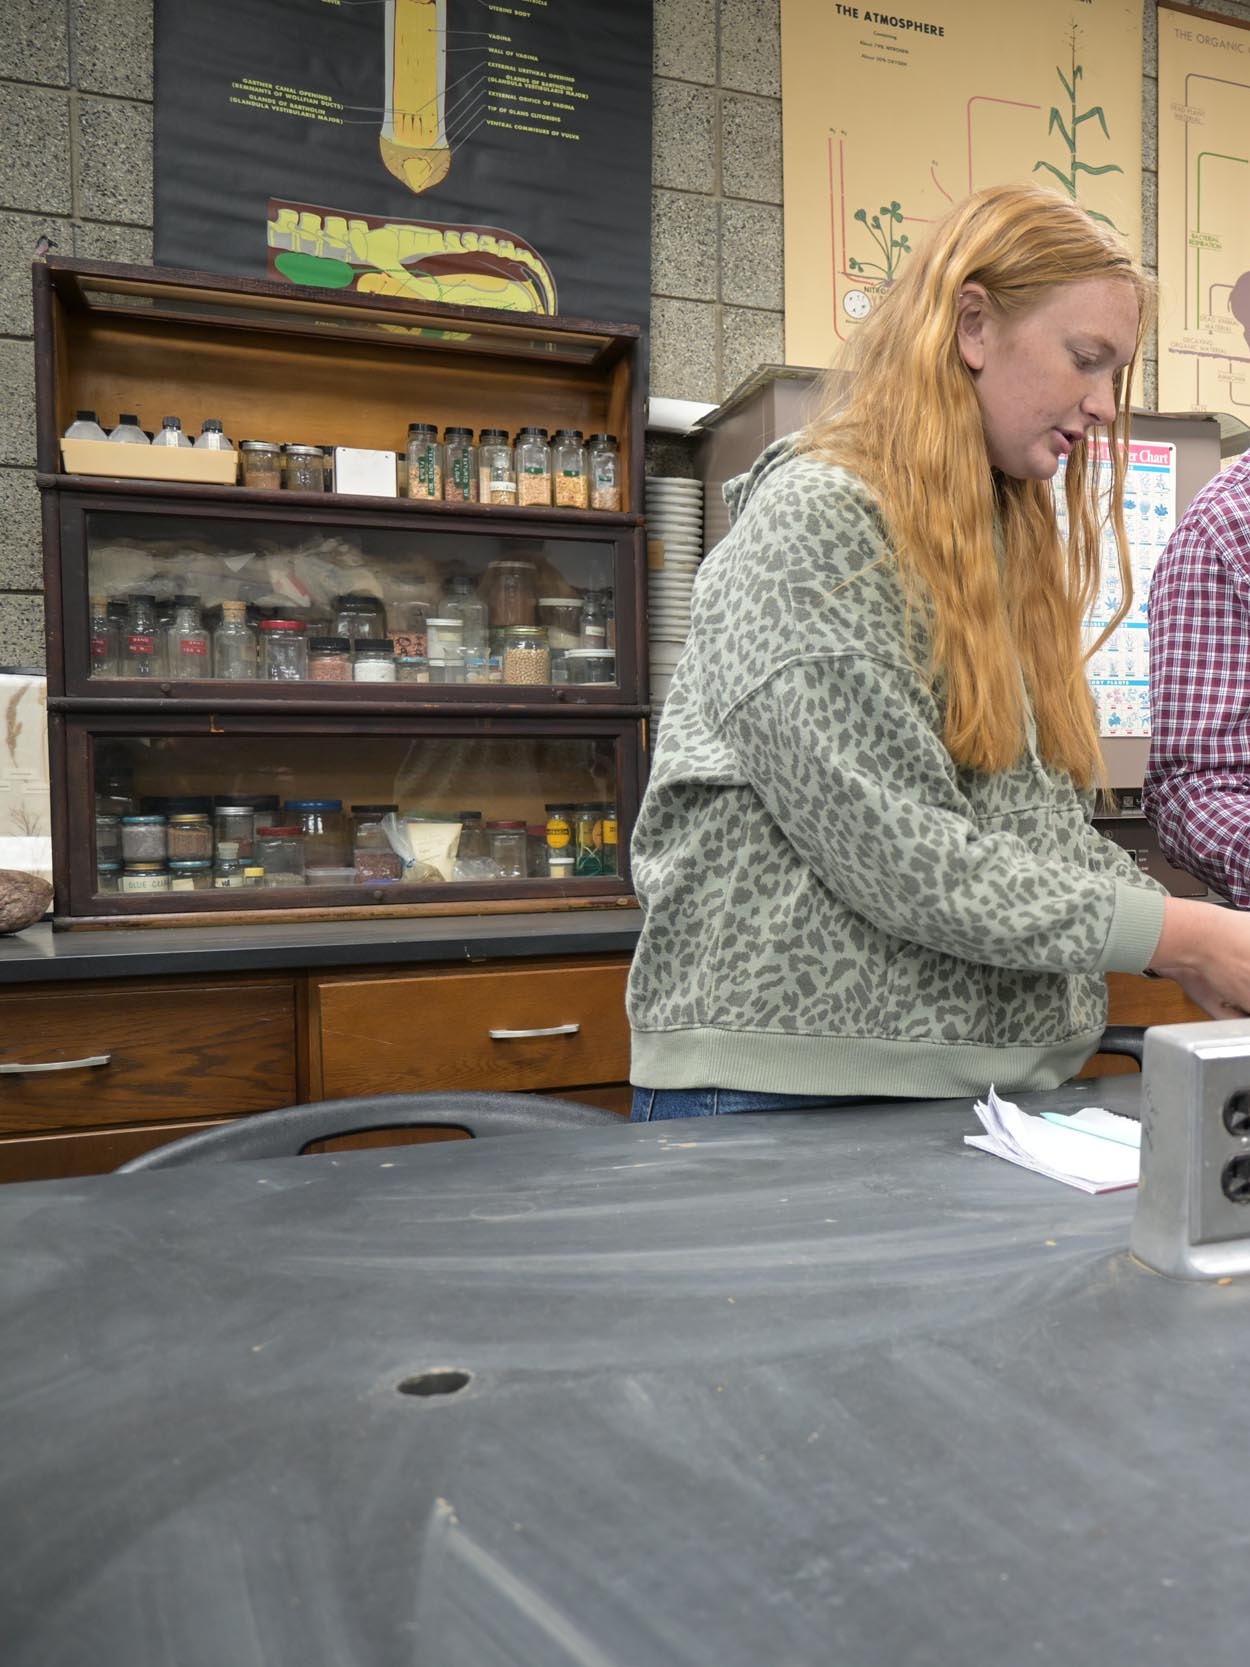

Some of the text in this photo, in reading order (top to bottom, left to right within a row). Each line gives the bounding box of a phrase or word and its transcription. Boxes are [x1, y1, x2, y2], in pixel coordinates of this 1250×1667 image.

[836, 4, 944, 36] THE ATMOSPHERE
[488, 34, 512, 42] VAGINA
[1174, 28, 1192, 42] THE
[1196, 33, 1246, 54] ORGANIC
[488, 62, 516, 72] EXTERNAL
[249, 94, 276, 104] GLANDS
[488, 90, 516, 100] EXTERNAL
[486, 120, 512, 128] VENTRAL
[1140, 450, 1168, 464] Chart
